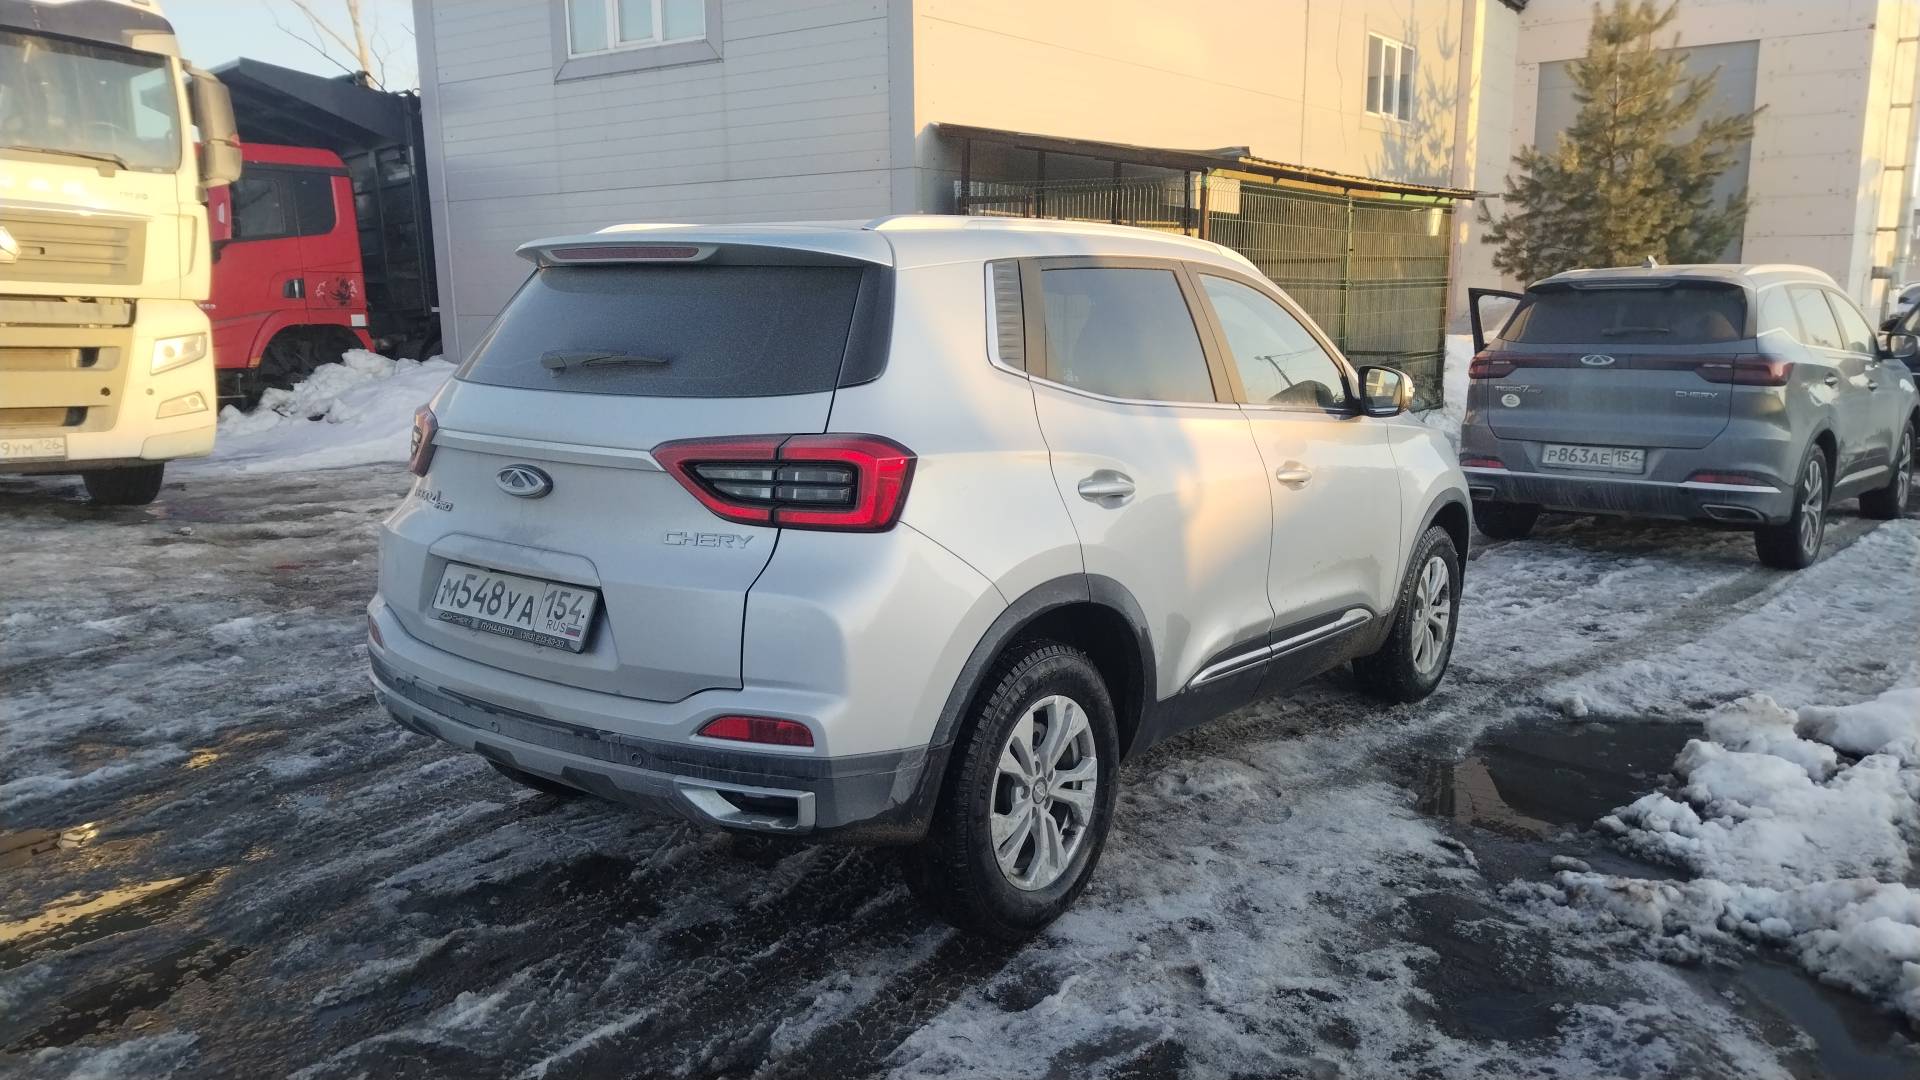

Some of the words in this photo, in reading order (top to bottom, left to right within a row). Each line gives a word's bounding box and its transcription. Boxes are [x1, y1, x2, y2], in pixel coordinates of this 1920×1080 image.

[1674, 389, 1719, 401] CHERY
[1614, 450, 1642, 464] 154
[664, 531, 755, 549] CHERY
[545, 589, 584, 625] 154
[545, 619, 566, 633] RUS
